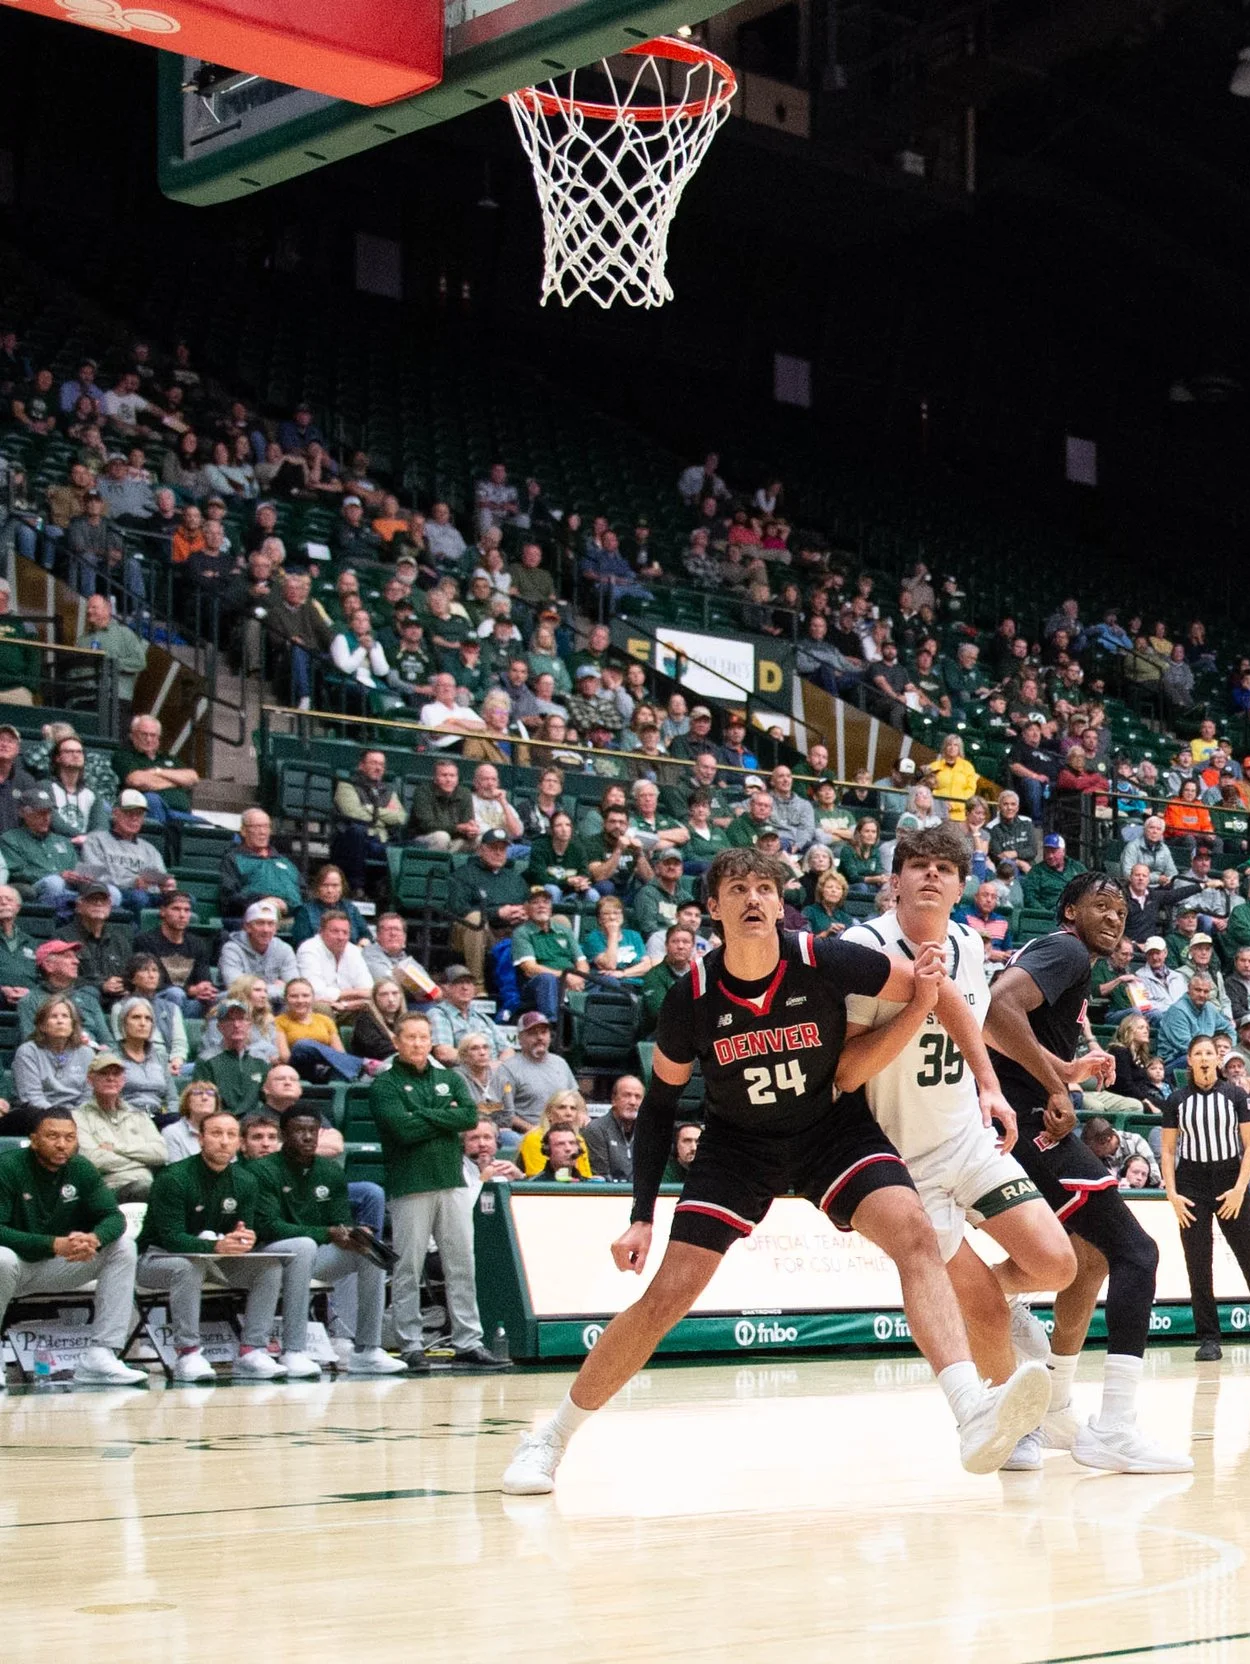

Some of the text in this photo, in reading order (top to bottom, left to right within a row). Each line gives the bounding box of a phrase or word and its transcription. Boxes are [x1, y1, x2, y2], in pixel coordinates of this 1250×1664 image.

[758, 659, 783, 693] D
[713, 1022, 823, 1066] DENVER
[917, 1033, 965, 1087] 35
[743, 1059, 807, 1105] 24
[1001, 1180, 1037, 1200] RA
[774, 1256, 892, 1274] FOR CSU ATHLE
[895, 1316, 912, 1337] fn
[1149, 1311, 1171, 1330] bo
[757, 1321, 798, 1343] fnbo
